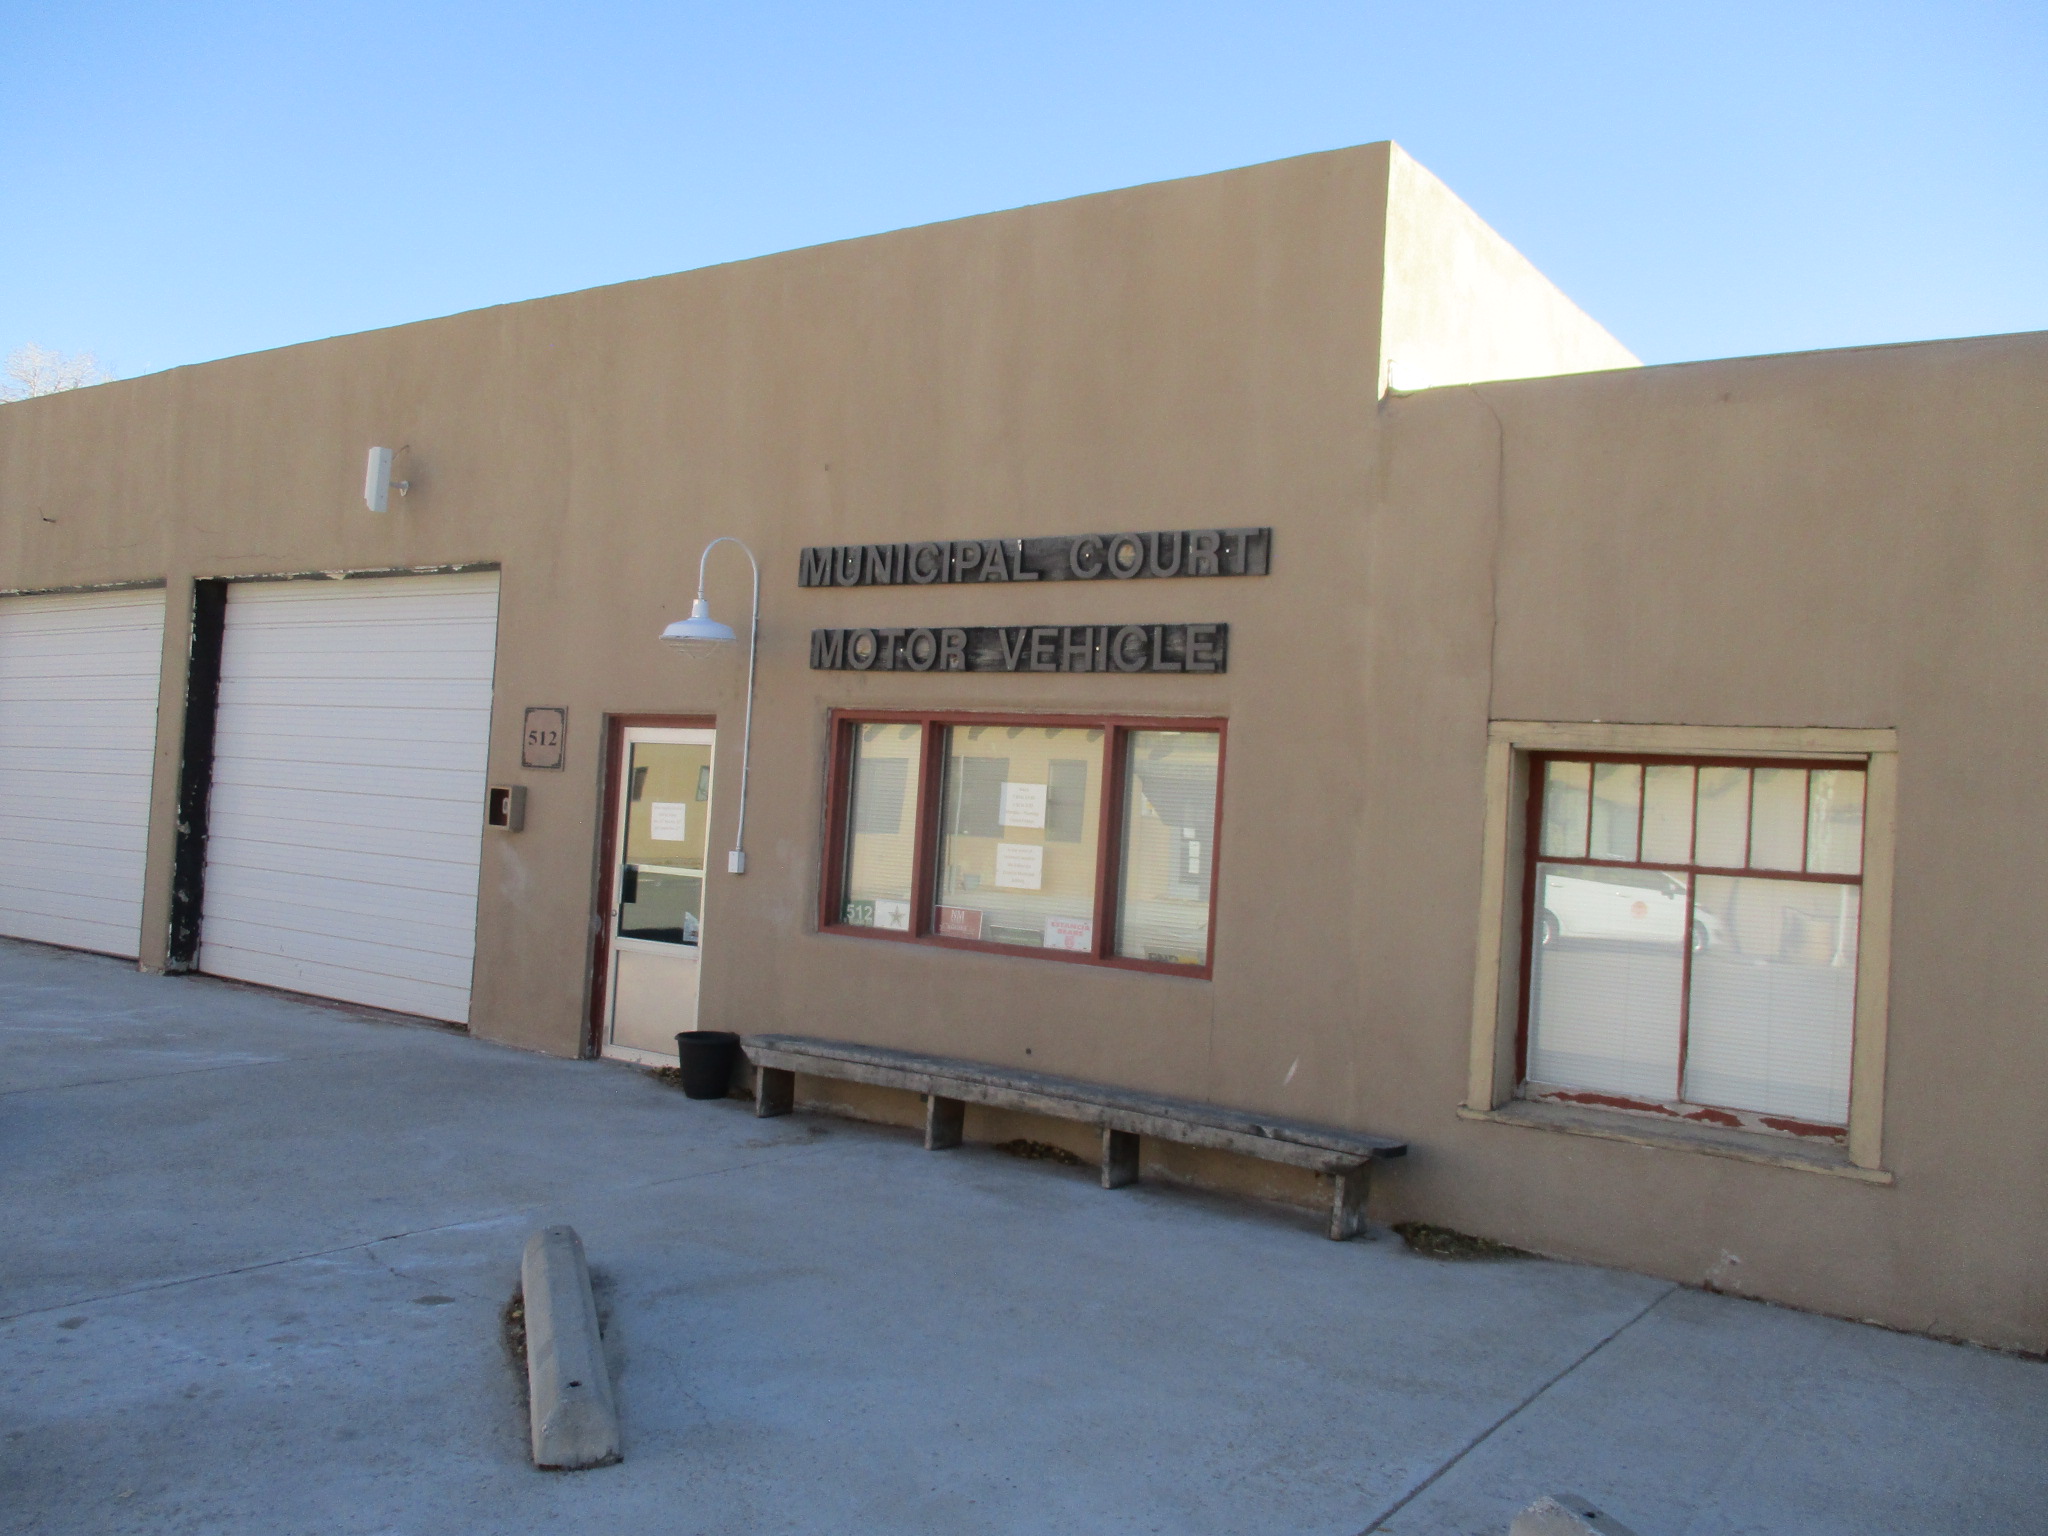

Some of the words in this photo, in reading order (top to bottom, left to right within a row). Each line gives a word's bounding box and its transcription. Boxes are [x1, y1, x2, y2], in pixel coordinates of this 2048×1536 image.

[800, 539, 1039, 587] MUNICIPAL
[1069, 530, 1261, 579] COURT
[812, 627, 968, 671] MOTOR
[1000, 625, 1218, 672] VEHICLE
[528, 730, 557, 747] 512
[847, 904, 873, 921] 512
